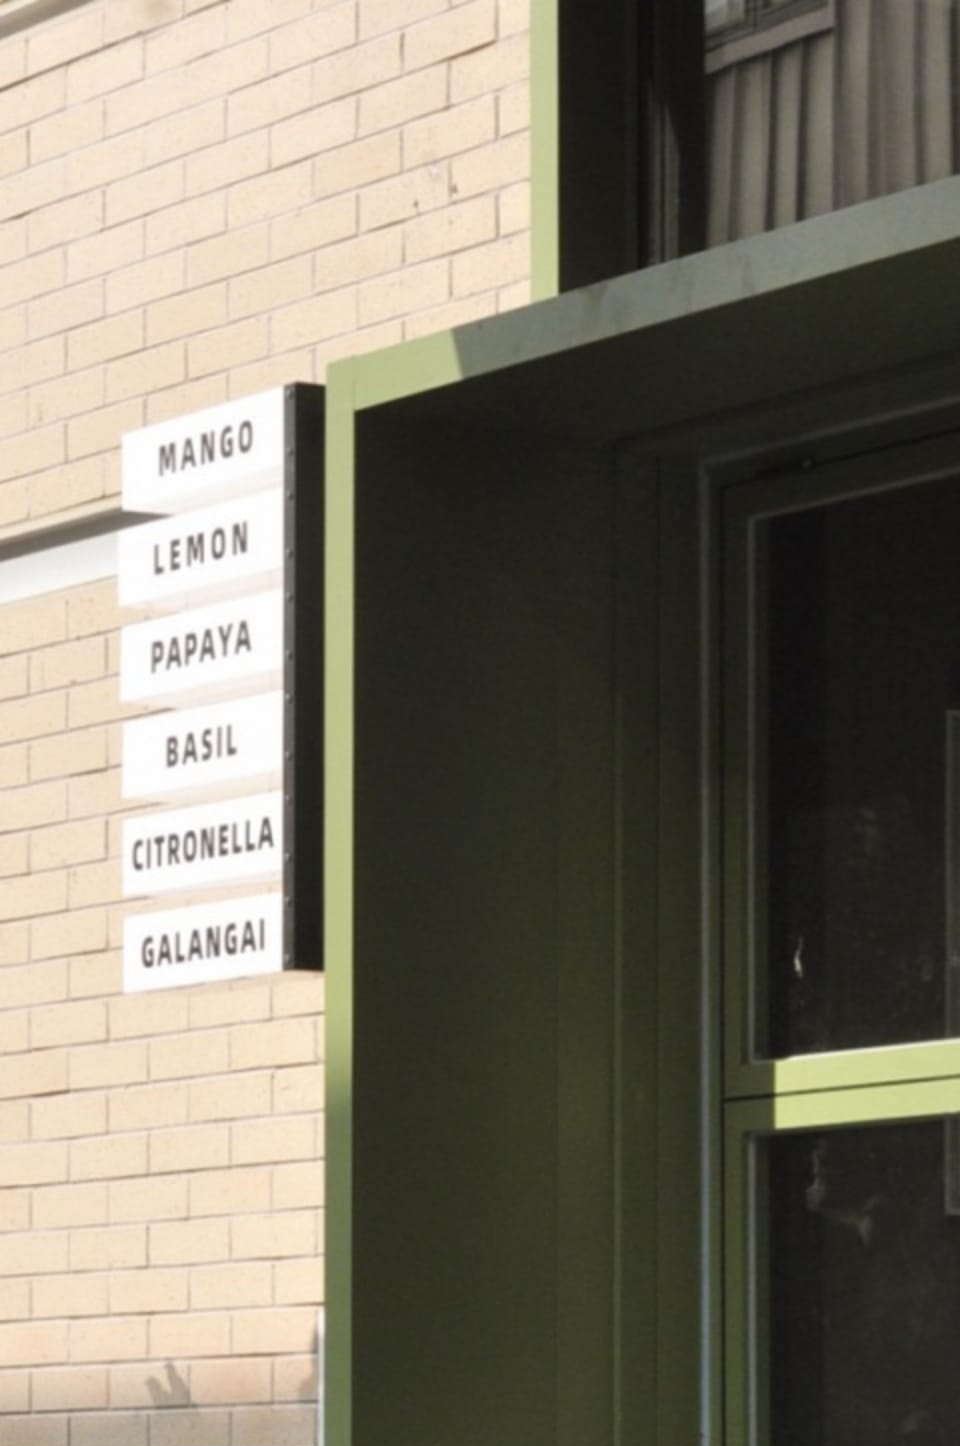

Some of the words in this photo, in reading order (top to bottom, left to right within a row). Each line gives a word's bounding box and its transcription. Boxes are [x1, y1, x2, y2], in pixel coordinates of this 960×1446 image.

[158, 420, 254, 476] MANGO
[153, 522, 248, 575] LEMON
[150, 620, 252, 672] PAPAYA
[165, 725, 238, 768] BASIL
[132, 817, 274, 871] CITRONELLA
[140, 919, 266, 969] GALANGAI
